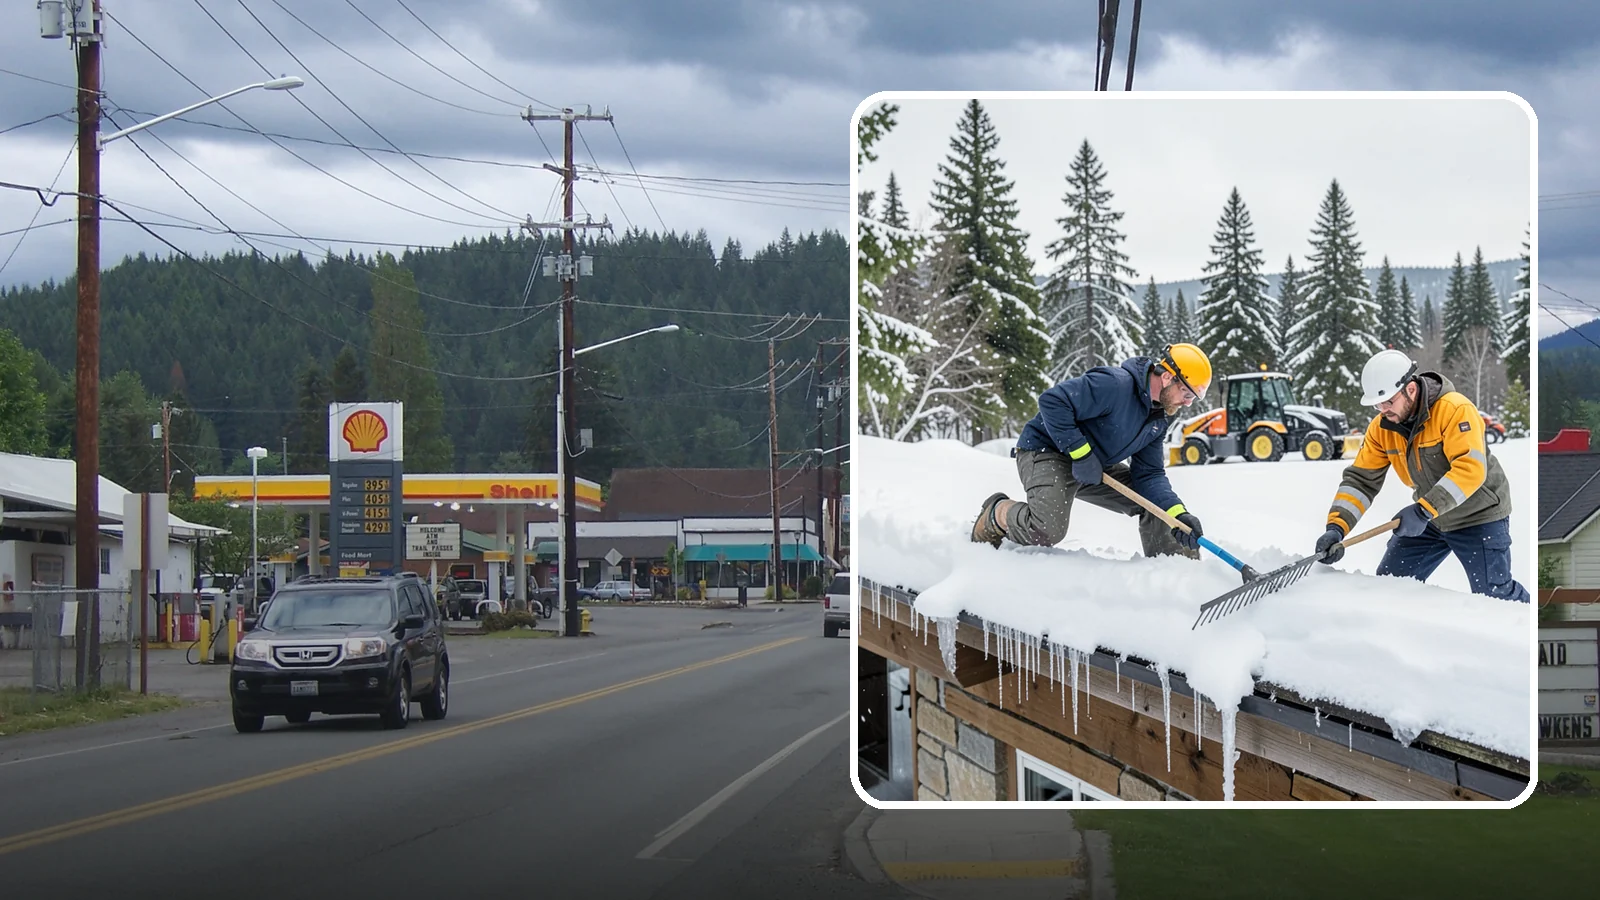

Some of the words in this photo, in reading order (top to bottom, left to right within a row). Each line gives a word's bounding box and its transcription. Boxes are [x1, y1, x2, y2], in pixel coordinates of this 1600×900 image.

[366, 480, 384, 490] 395
[490, 484, 547, 499] Shell
[366, 494, 384, 504] 405
[366, 508, 384, 518] 415
[366, 522, 384, 532] 429
[1539, 643, 1567, 665] AID
